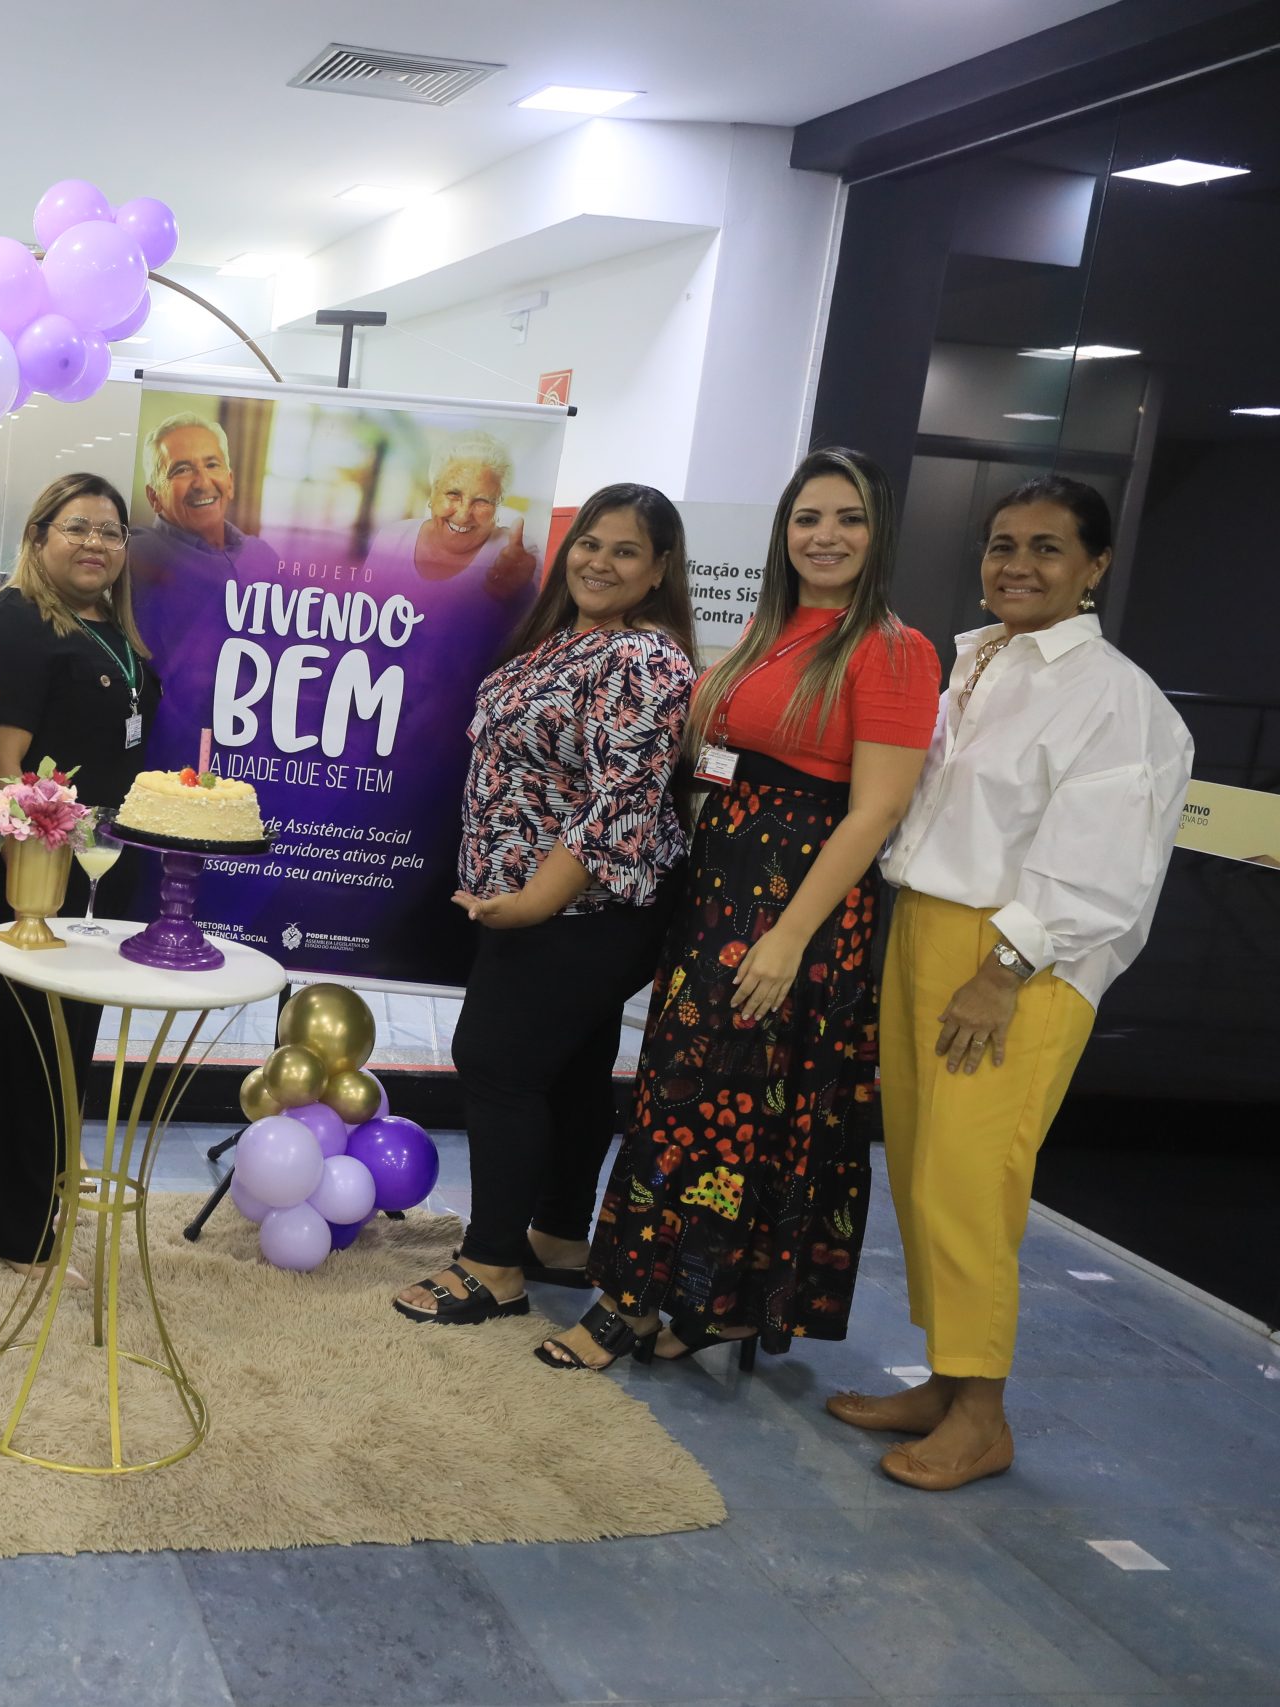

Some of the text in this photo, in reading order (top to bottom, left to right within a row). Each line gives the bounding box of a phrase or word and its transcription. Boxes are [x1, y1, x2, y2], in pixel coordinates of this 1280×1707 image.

[277, 560, 373, 583] PROJETO
[736, 587, 761, 603] Sis
[225, 579, 424, 648] VIVENDO
[694, 607, 744, 625] Contra
[213, 638, 404, 758] BEM
[209, 752, 394, 793] A IDADE QUE SE TEM
[1181, 814, 1209, 826] TIVA DO
[1183, 804, 1210, 816] ATIVO
[284, 818, 363, 840] Assistência
[366, 827, 412, 845] Social
[270, 842, 425, 870] servidores ativos pela
[263, 862, 283, 877] do
[284, 867, 310, 880] seu
[312, 869, 395, 889] aniversário.
[233, 924, 244, 932] DE
[305, 932, 370, 943] PODER LEGISLATIVO
[240, 934, 269, 943] SOCIAL
